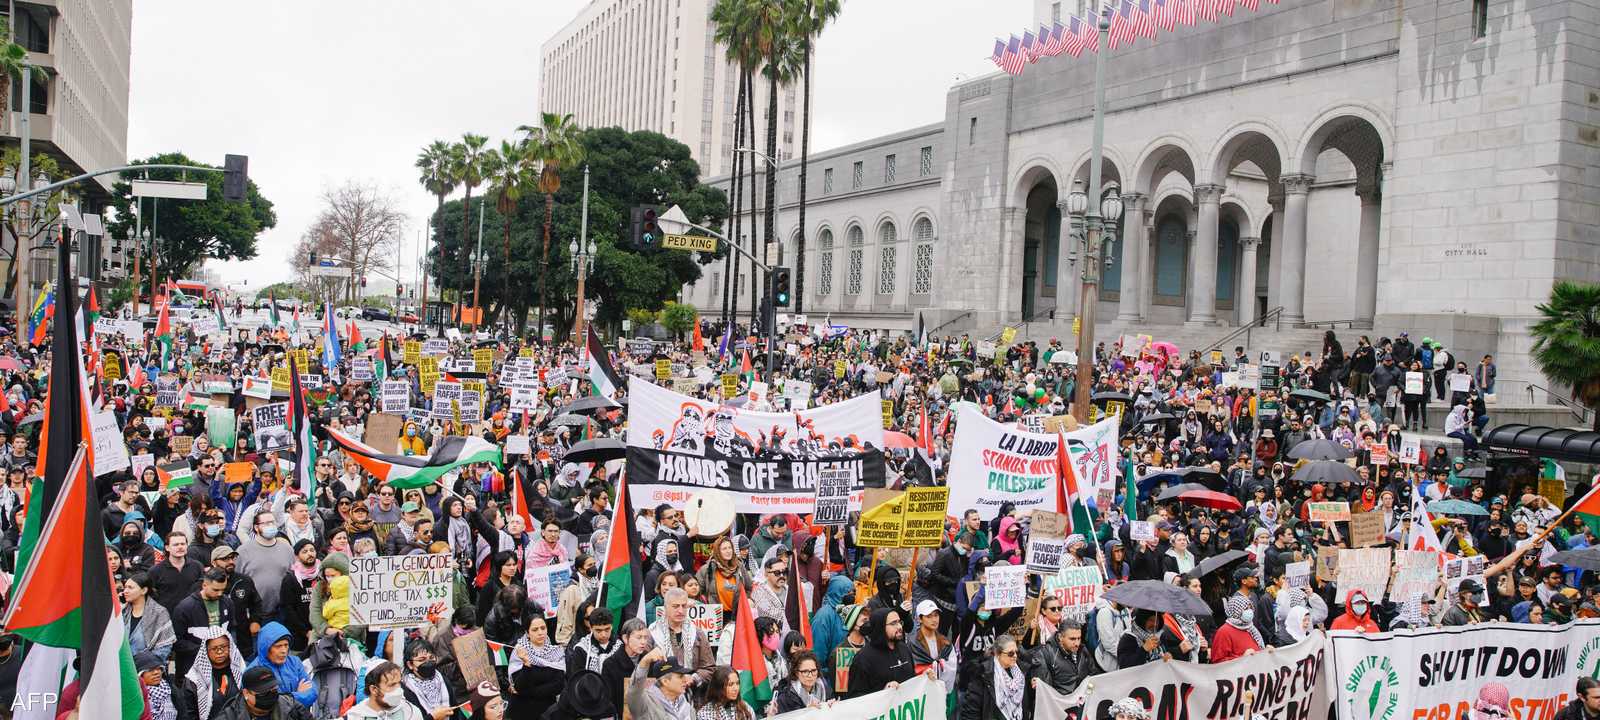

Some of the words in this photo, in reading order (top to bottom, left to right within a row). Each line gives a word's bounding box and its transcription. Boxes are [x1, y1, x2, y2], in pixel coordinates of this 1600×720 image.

[667, 236, 687, 247] PED
[689, 238, 712, 249] XING
[1466, 248, 1487, 256] HALL
[255, 404, 286, 422] FREE
[411, 410, 430, 418] HANDS
[998, 433, 1014, 451] LA
[1017, 438, 1058, 457] LABOR
[982, 449, 1028, 475] STANDS
[657, 453, 730, 488] HANDS
[742, 460, 780, 491] OFF
[820, 471, 837, 479] STAND
[818, 487, 835, 497] END
[836, 486, 850, 496] THE
[909, 490, 947, 502] RESISTANCE
[751, 495, 770, 505] Party
[816, 506, 848, 521] NOW!
[907, 503, 915, 512] IS
[915, 502, 945, 513] JUSTIFIED
[862, 520, 879, 530] WHEN
[906, 519, 922, 528] WHEN
[923, 519, 942, 528] PEOPLE
[861, 530, 872, 538] ARE
[905, 530, 915, 538] ARE
[1032, 542, 1055, 554] HANDS
[350, 558, 380, 573] STOP
[401, 555, 452, 571] GENOCIDE
[1033, 552, 1060, 566] RAFAH!
[360, 573, 385, 590] LET
[393, 571, 429, 589] GAZA
[353, 591, 368, 605] NO
[374, 590, 399, 603] MORE
[405, 589, 422, 601] TAX
[426, 585, 448, 599] $$$
[1055, 584, 1096, 607] RAFAH
[369, 609, 394, 623] FUND
[1419, 647, 1475, 687] SHUT
[1475, 646, 1498, 678] IT
[1496, 644, 1570, 679] DOWN
[1345, 659, 1366, 693] SHUT
[1366, 656, 1378, 669] IT
[1206, 665, 1291, 720] RISING
[1291, 648, 1325, 697] FOR
